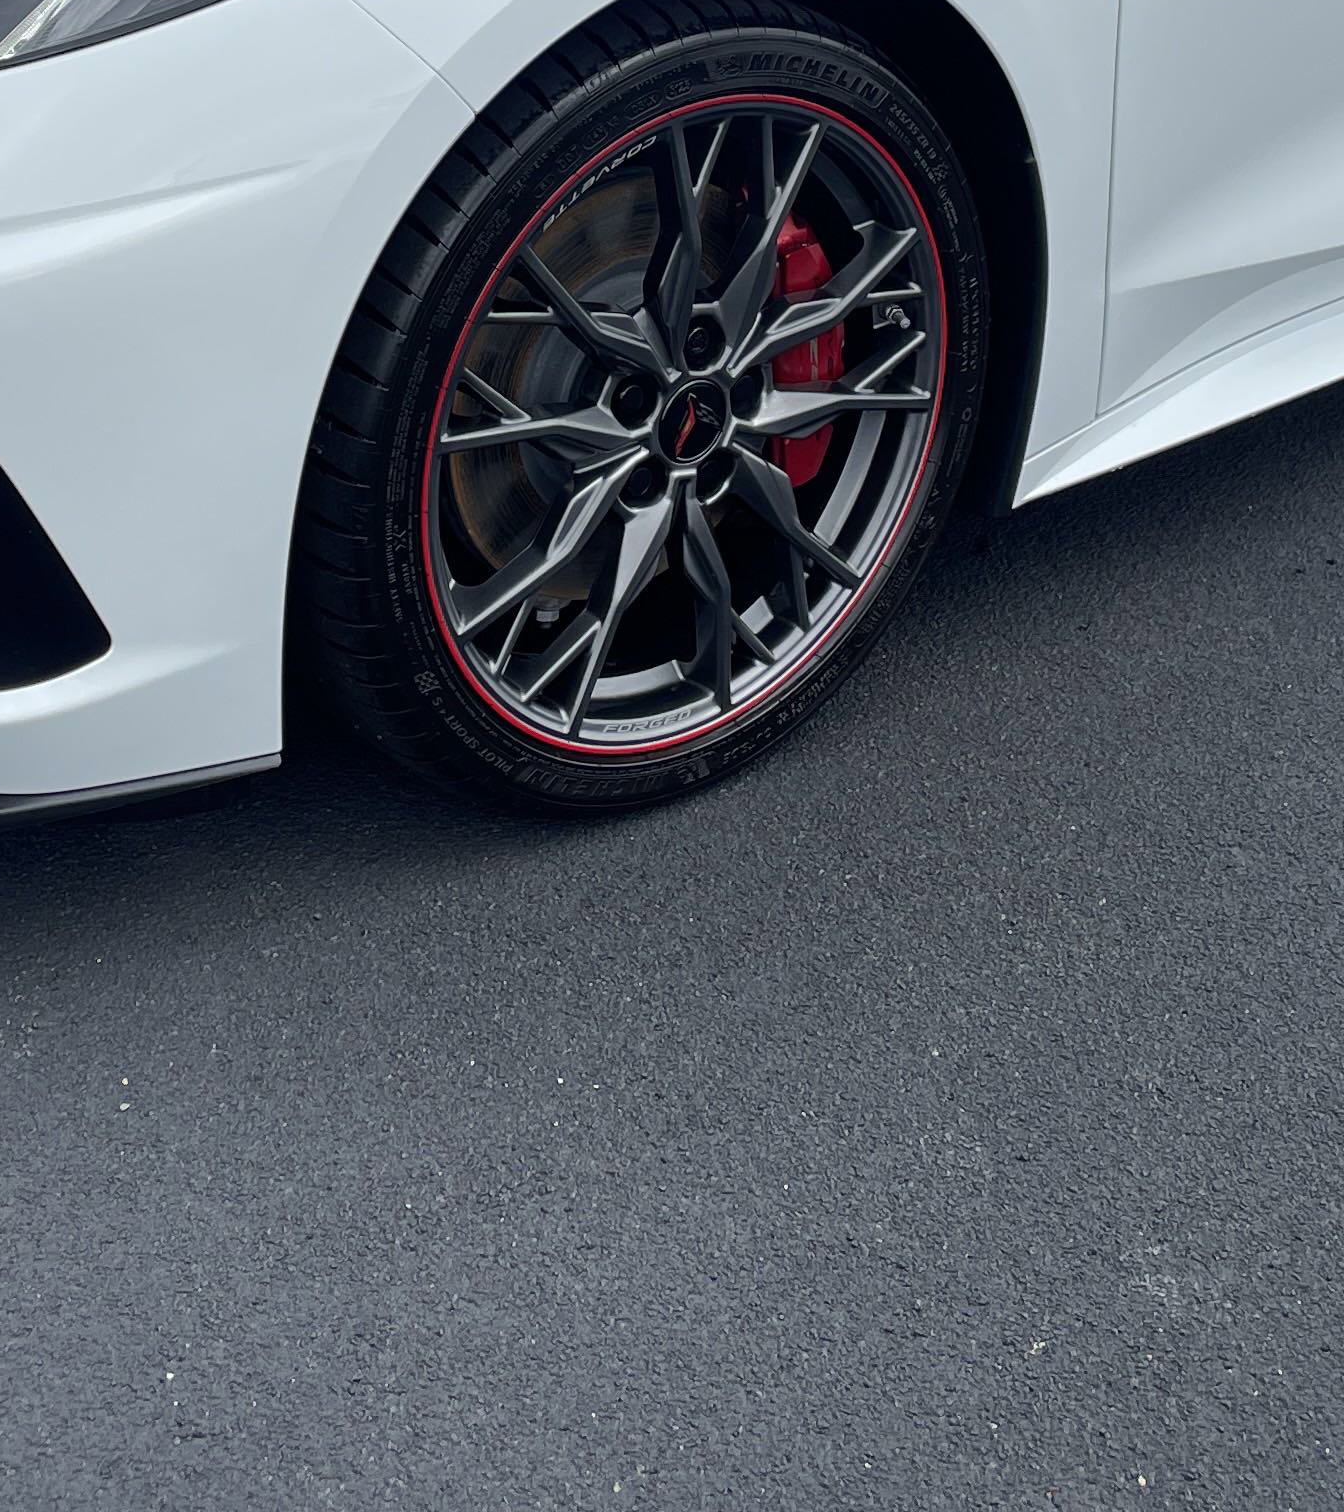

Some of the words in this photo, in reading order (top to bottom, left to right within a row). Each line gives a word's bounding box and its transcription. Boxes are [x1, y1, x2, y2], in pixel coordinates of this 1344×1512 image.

[747, 51, 882, 105] MICHELIN
[542, 135, 657, 233] CORVETTE
[443, 714, 478, 750] SPORT
[602, 709, 693, 734] FORGED
[478, 748, 515, 776] PILOT
